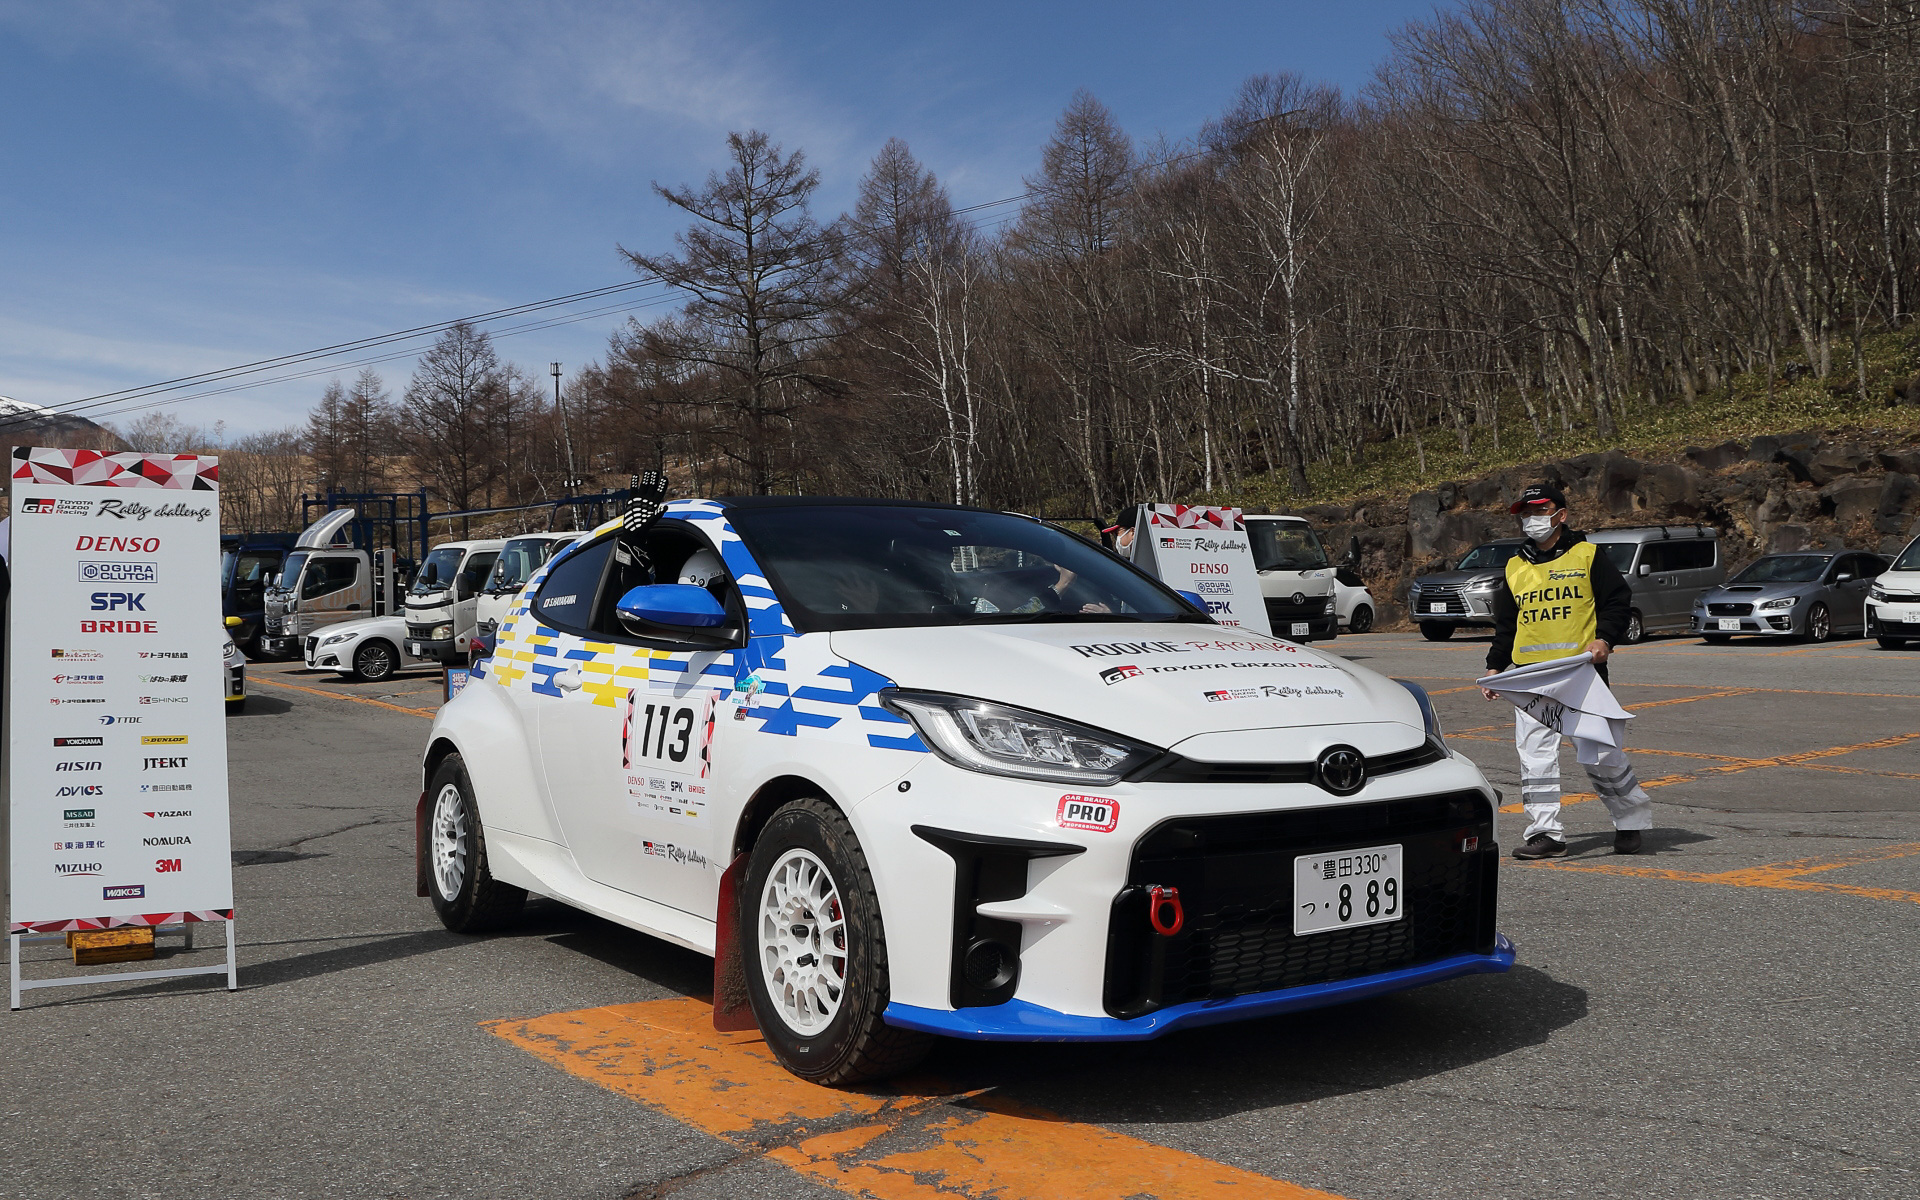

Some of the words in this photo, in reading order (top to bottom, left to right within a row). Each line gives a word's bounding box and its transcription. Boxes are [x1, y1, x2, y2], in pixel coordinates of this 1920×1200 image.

[22, 501, 55, 514] GR
[96, 500, 151, 521] Rally
[154, 503, 212, 522] challenge
[76, 536, 160, 552] DENSO
[1160, 540, 1175, 548] GR
[1194, 538, 1220, 552] Rally
[1220, 540, 1248, 553] challenge
[100, 564, 154, 573] OGURA
[1190, 563, 1229, 574] DENSO
[100, 572, 154, 581] CLUTCH
[90, 592, 146, 611] SPK
[1515, 586, 1584, 608] OFFICIAL
[1206, 601, 1233, 614] SPK
[1522, 606, 1572, 624] STAFF
[80, 620, 158, 633] BRIDE
[1069, 642, 1191, 658] ROOKIE
[1184, 640, 1298, 653] RACING
[1102, 667, 1144, 686] GR
[1146, 662, 1228, 673] TOYOTA
[1206, 693, 1232, 702] GR
[1259, 685, 1302, 698] Rally
[1305, 686, 1344, 698] challenge
[642, 704, 694, 762] 113
[56, 762, 102, 772] AISIN
[142, 757, 189, 771] JTEKT
[628, 776, 644, 786] DENSO
[670, 781, 683, 792] SPK
[56, 785, 104, 797] ADVICS
[688, 785, 706, 794] BRIDE
[1084, 796, 1115, 805] BEAUTY
[1068, 804, 1106, 822] PRO
[1062, 823, 1106, 831] PROFESSIONAL
[64, 840, 106, 850] 東海理化
[142, 836, 192, 846] NOMURA
[667, 844, 686, 865] Rally
[54, 862, 102, 874] MIZUHO
[155, 858, 182, 873] 3M
